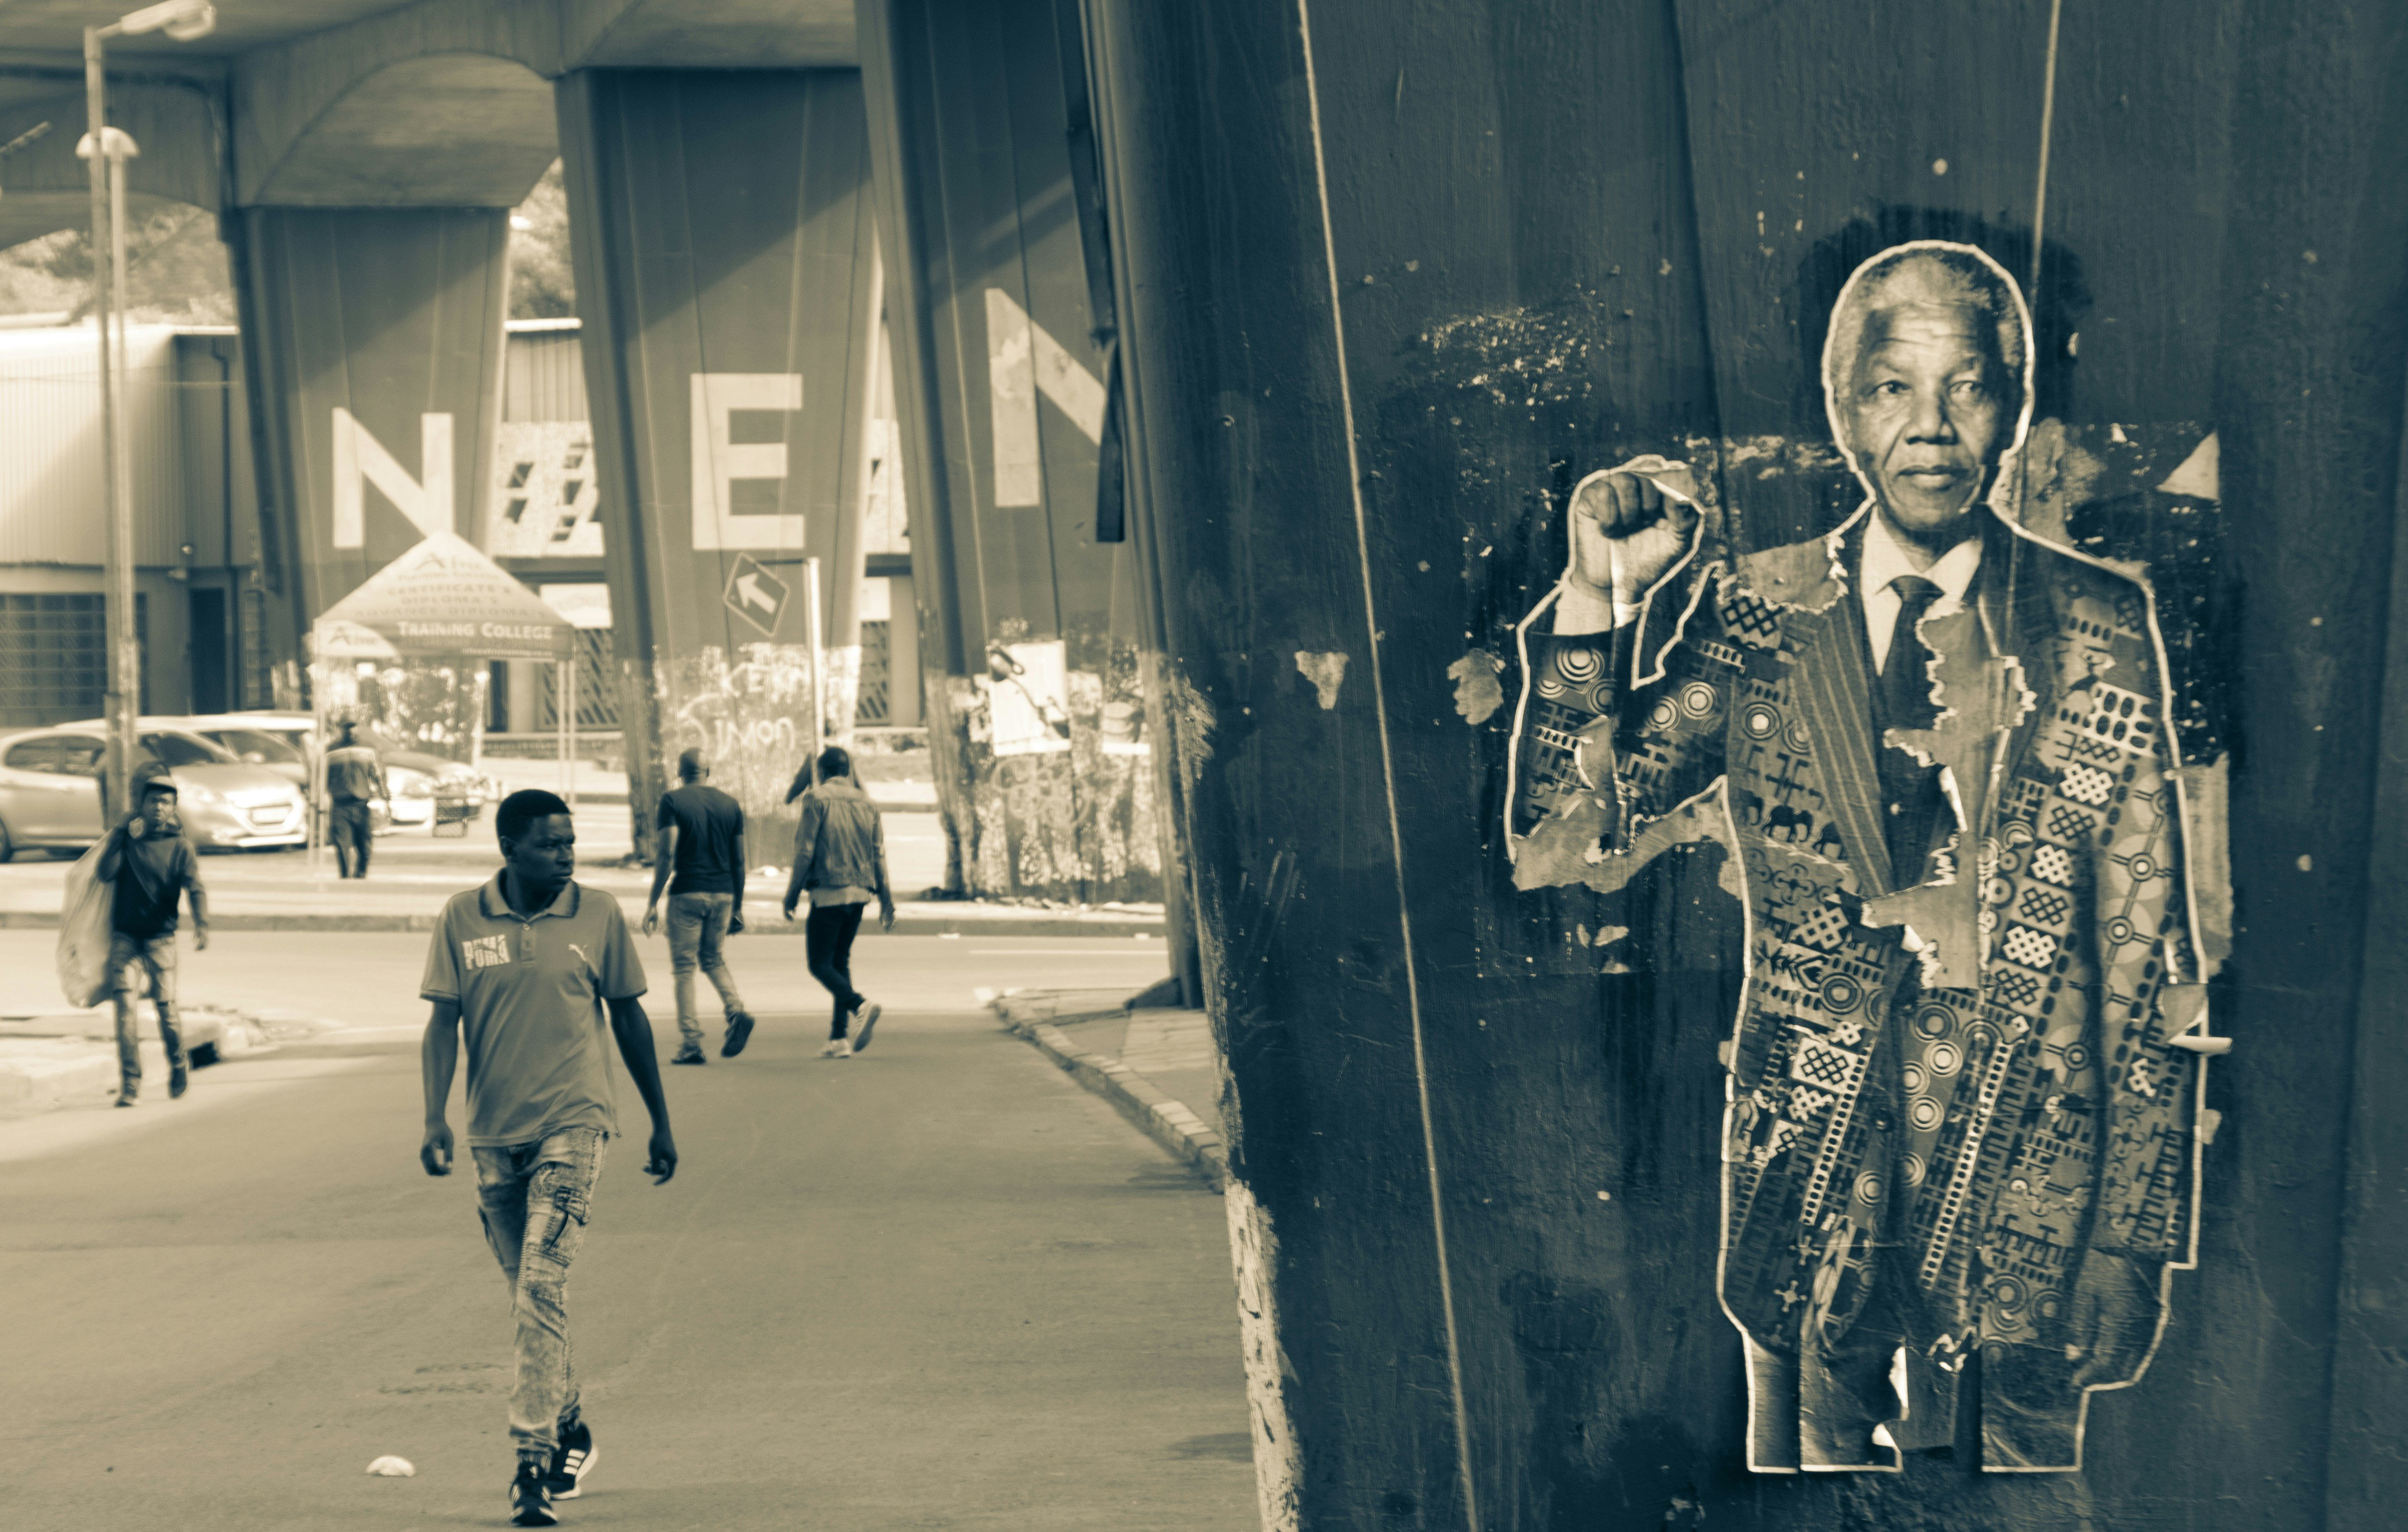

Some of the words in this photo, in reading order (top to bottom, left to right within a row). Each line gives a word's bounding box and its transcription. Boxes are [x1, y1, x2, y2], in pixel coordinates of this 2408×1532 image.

[332, 407, 454, 549] N
[690, 373, 805, 550] E
[397, 621, 475, 637] TRAINING
[480, 622, 552, 640] COLLEGE
[462, 934, 510, 970] PUMA
